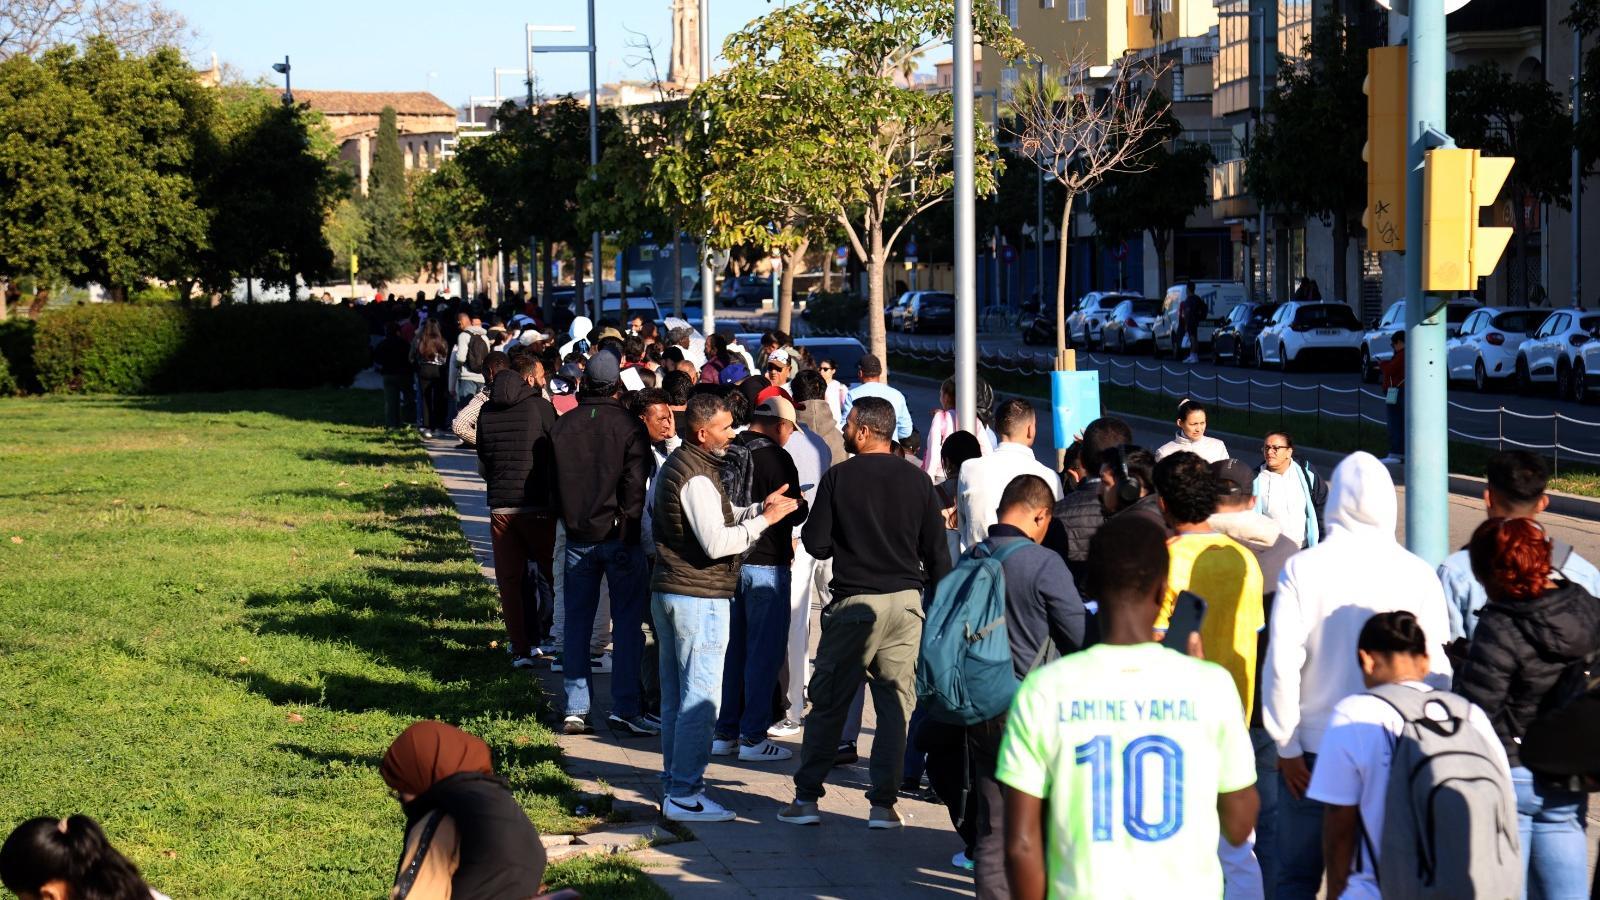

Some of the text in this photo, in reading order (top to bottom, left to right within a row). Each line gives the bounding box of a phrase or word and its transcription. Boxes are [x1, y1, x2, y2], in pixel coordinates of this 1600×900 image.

[1059, 700, 1197, 721] LAMINE YAMAL
[1076, 735, 1183, 841] 10
